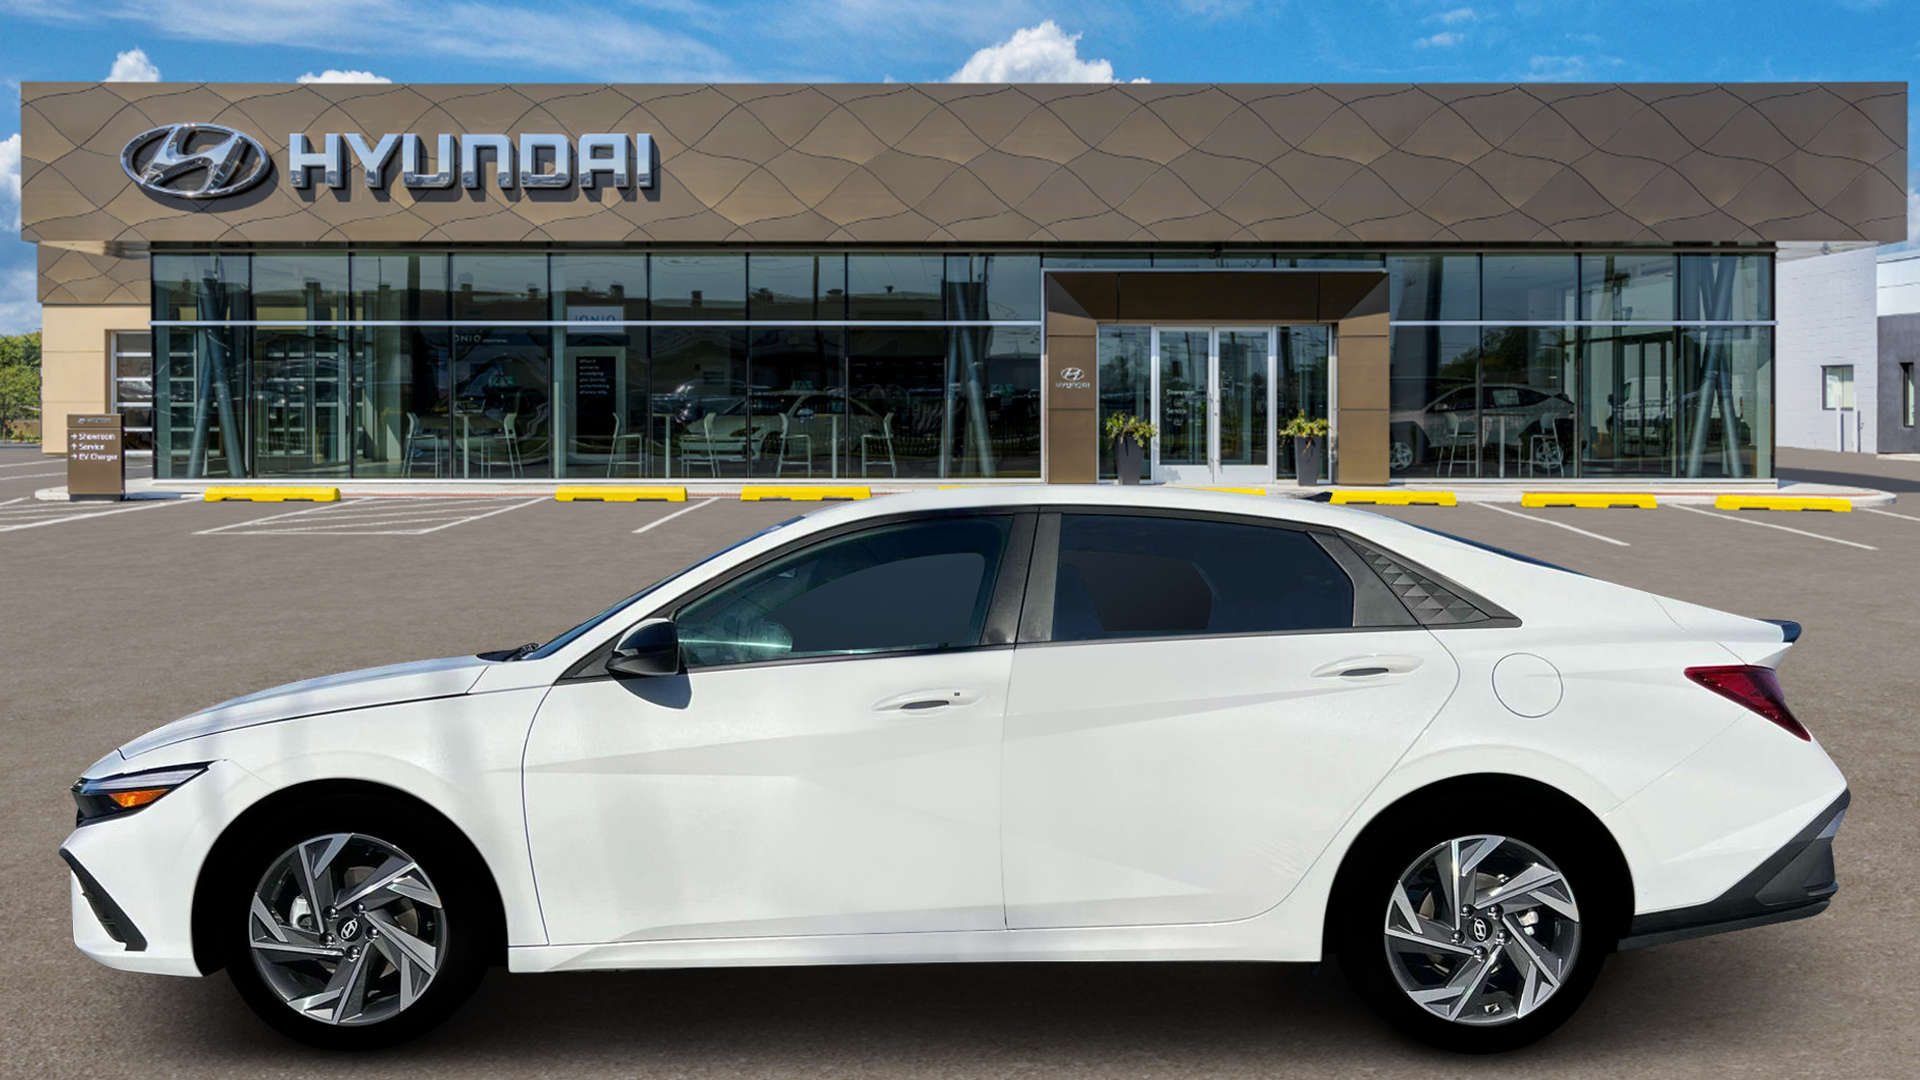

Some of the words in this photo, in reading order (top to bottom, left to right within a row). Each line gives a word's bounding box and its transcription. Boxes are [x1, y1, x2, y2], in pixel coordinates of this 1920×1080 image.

[289, 133, 654, 188] HYUNDAI
[78, 442, 105, 450] Service
[90, 453, 118, 462] Charger
